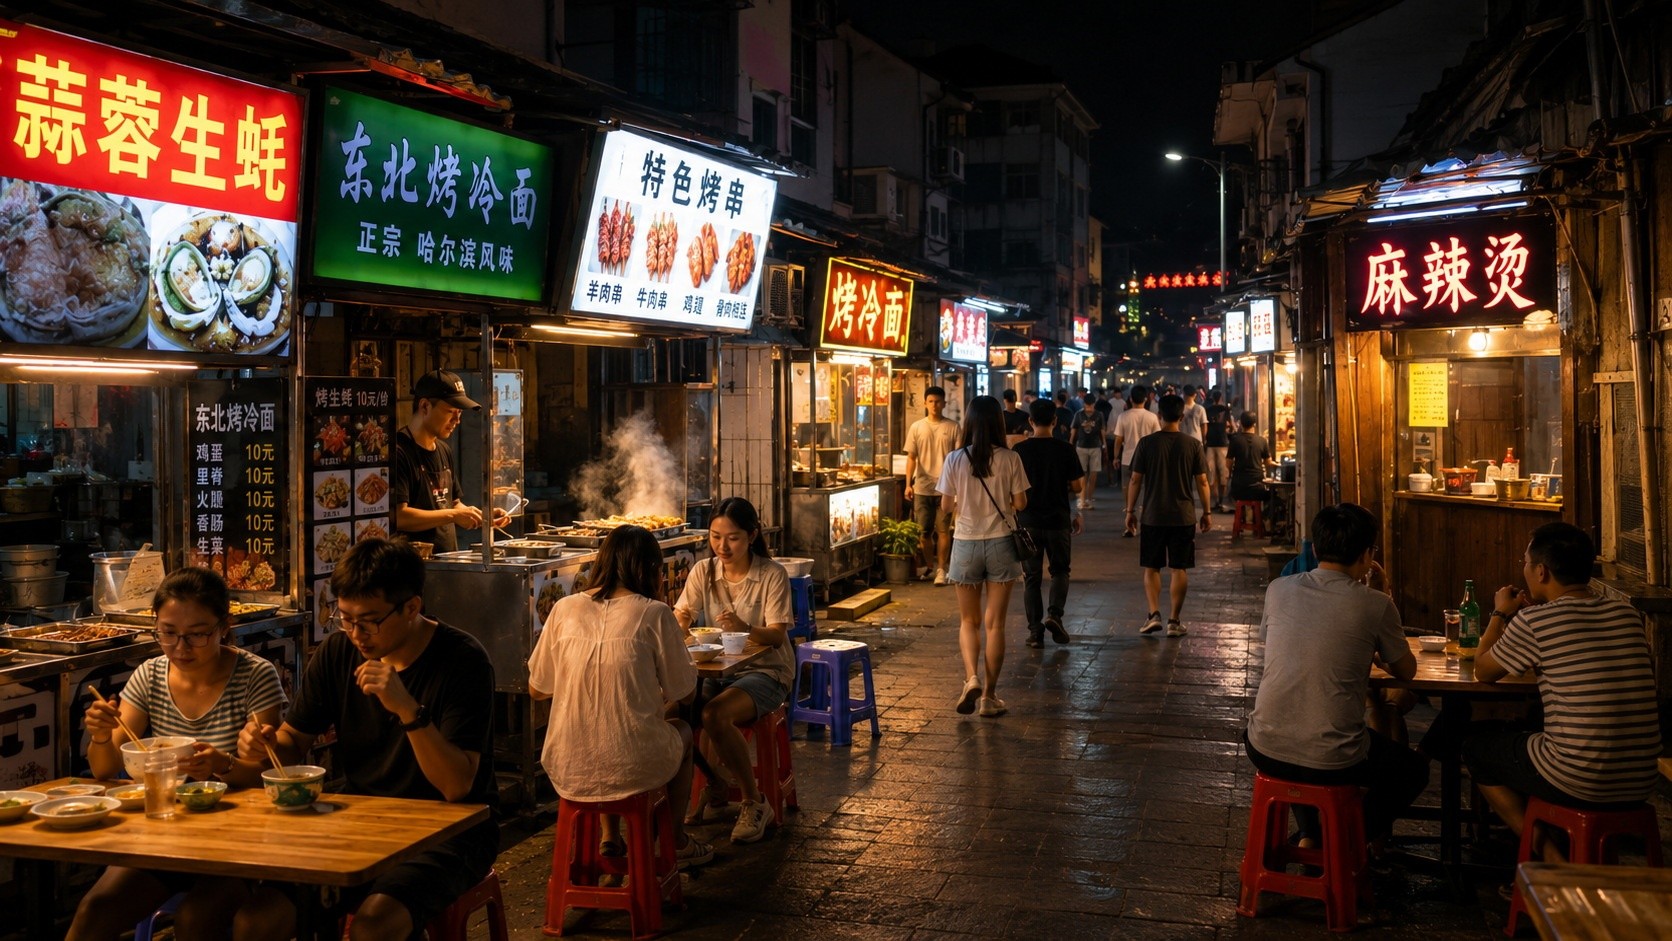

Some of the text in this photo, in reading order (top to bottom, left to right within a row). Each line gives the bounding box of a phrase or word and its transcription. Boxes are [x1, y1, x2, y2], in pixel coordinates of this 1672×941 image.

[14, 53, 288, 203] 蒜蓉生蚝
[340, 121, 538, 230] 东北烤冷面
[641, 150, 745, 219] 特色烤串
[358, 220, 514, 274] 正宗 哈尔滨风味
[1361, 232, 1536, 316] 麻辣烫
[587, 280, 623, 305] 羊肉串
[637, 287, 668, 311] 牛肉串
[829, 272, 904, 343] 烤冷面
[196, 402, 276, 433] 东北烤冷面
[246, 444, 275, 461] 10元
[196, 466, 275, 486] 里脊 10元
[246, 492, 275, 509] 10元
[196, 513, 275, 533] 香肠 10元
[196, 536, 275, 556] 生菜 10元
